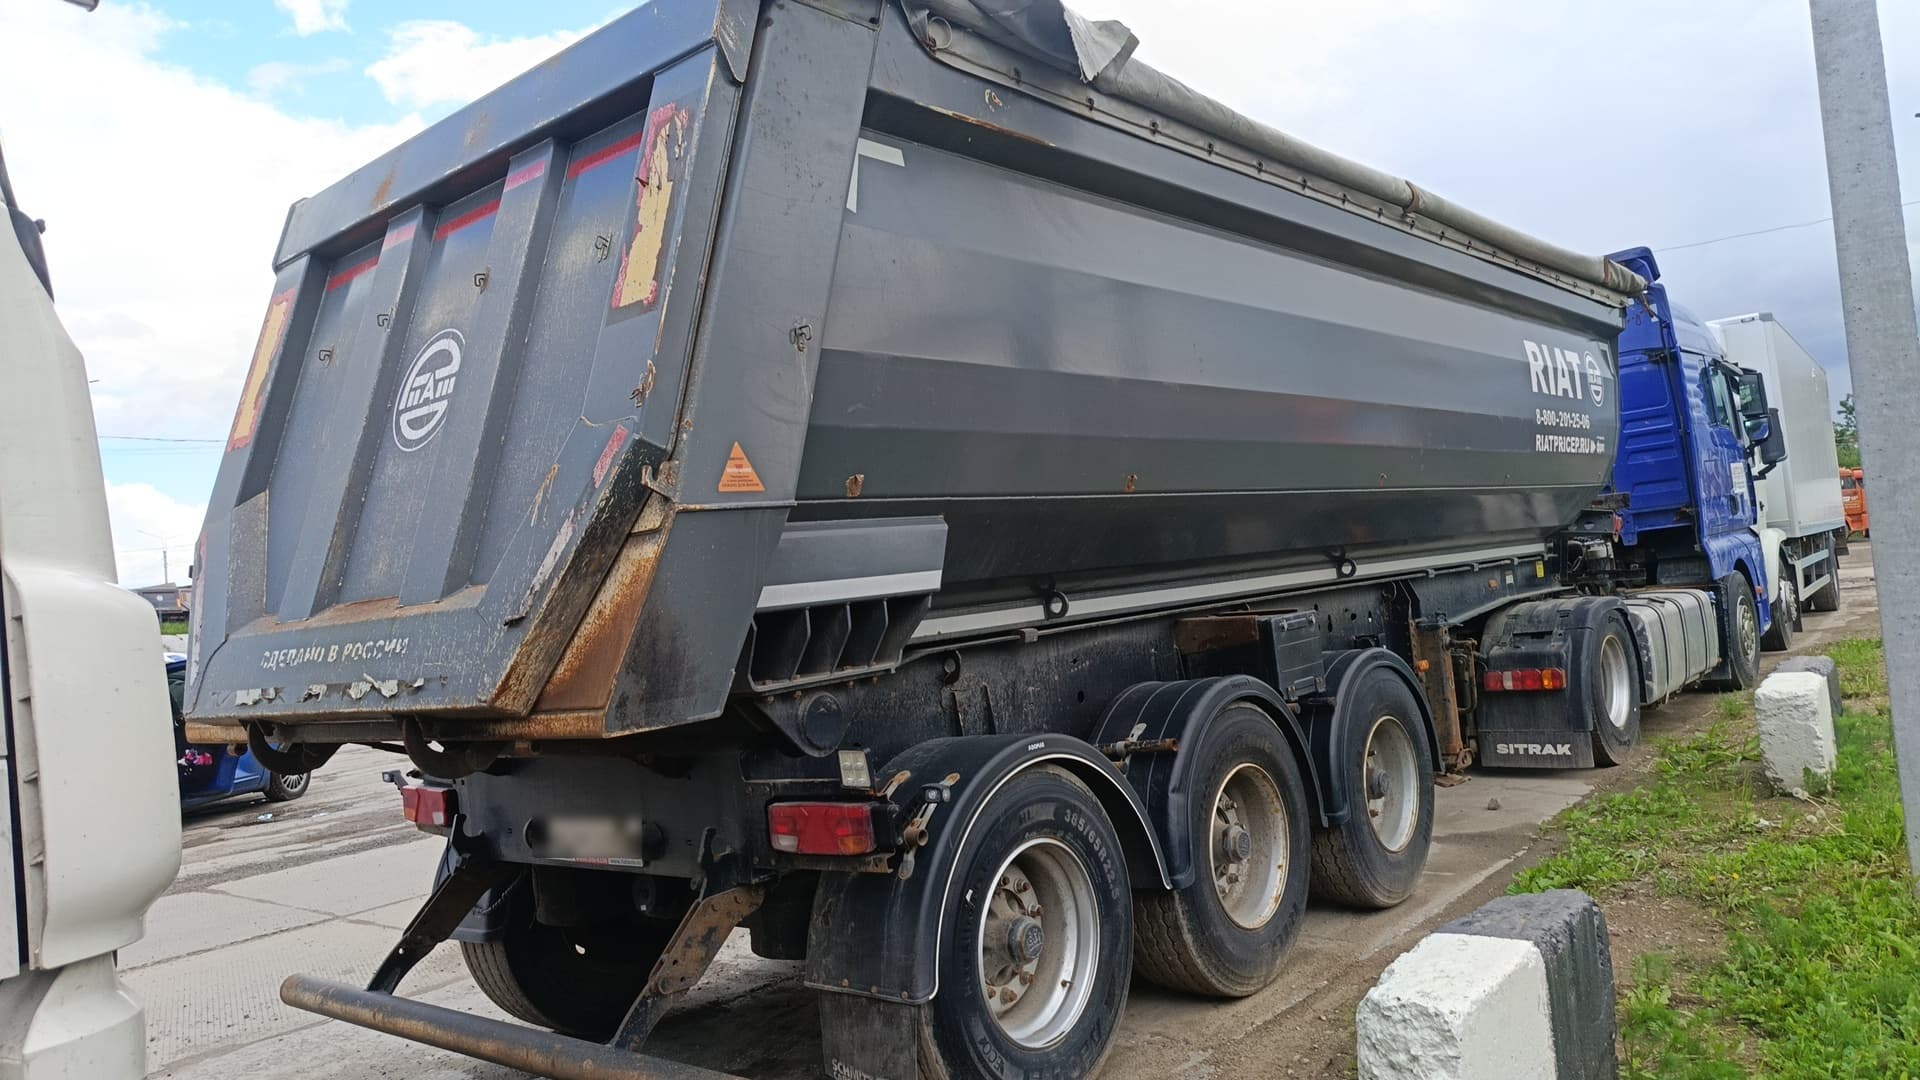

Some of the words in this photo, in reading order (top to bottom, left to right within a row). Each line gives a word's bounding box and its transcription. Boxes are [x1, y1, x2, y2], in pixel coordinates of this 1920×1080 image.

[1523, 339, 1583, 400] RIAT
[1535, 434, 1590, 454] RIATPRICEP.RU
[328, 645, 339, 662] В
[342, 638, 409, 662] РОССИИ
[1496, 743, 1572, 755] SITRAK
